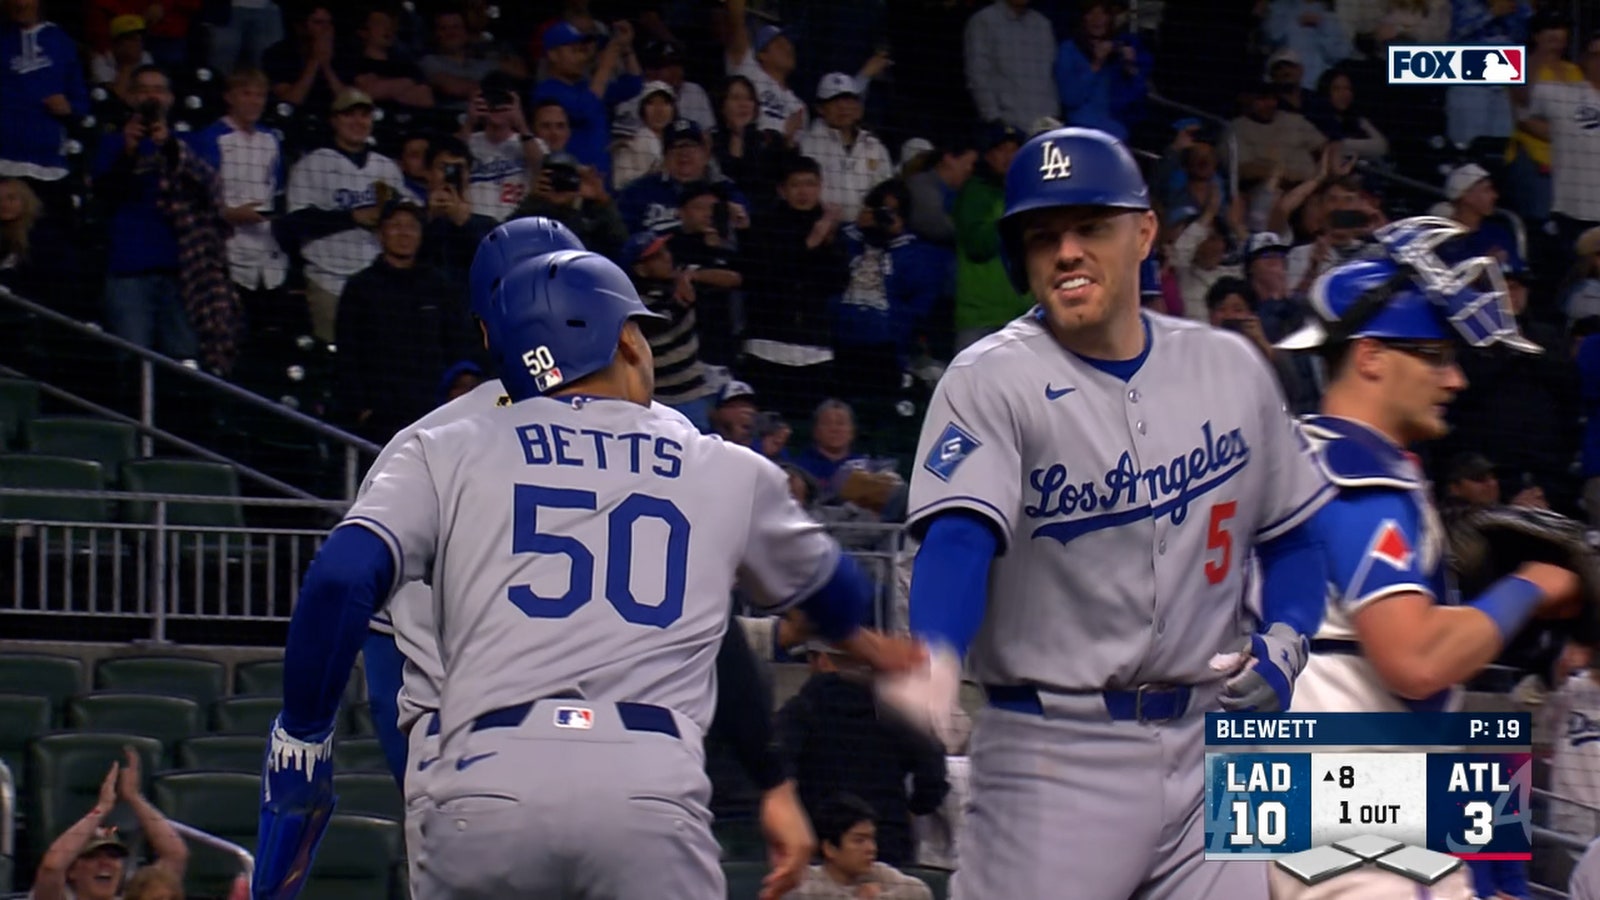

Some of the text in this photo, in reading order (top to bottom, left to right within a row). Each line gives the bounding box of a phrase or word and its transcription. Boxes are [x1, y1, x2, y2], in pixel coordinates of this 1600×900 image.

[1039, 140, 1071, 181] LA
[522, 345, 555, 376] 50
[515, 424, 683, 478] BETTS
[1025, 420, 1250, 526] Los Angeles
[508, 483, 691, 629] 50
[1204, 500, 1237, 586] 5
